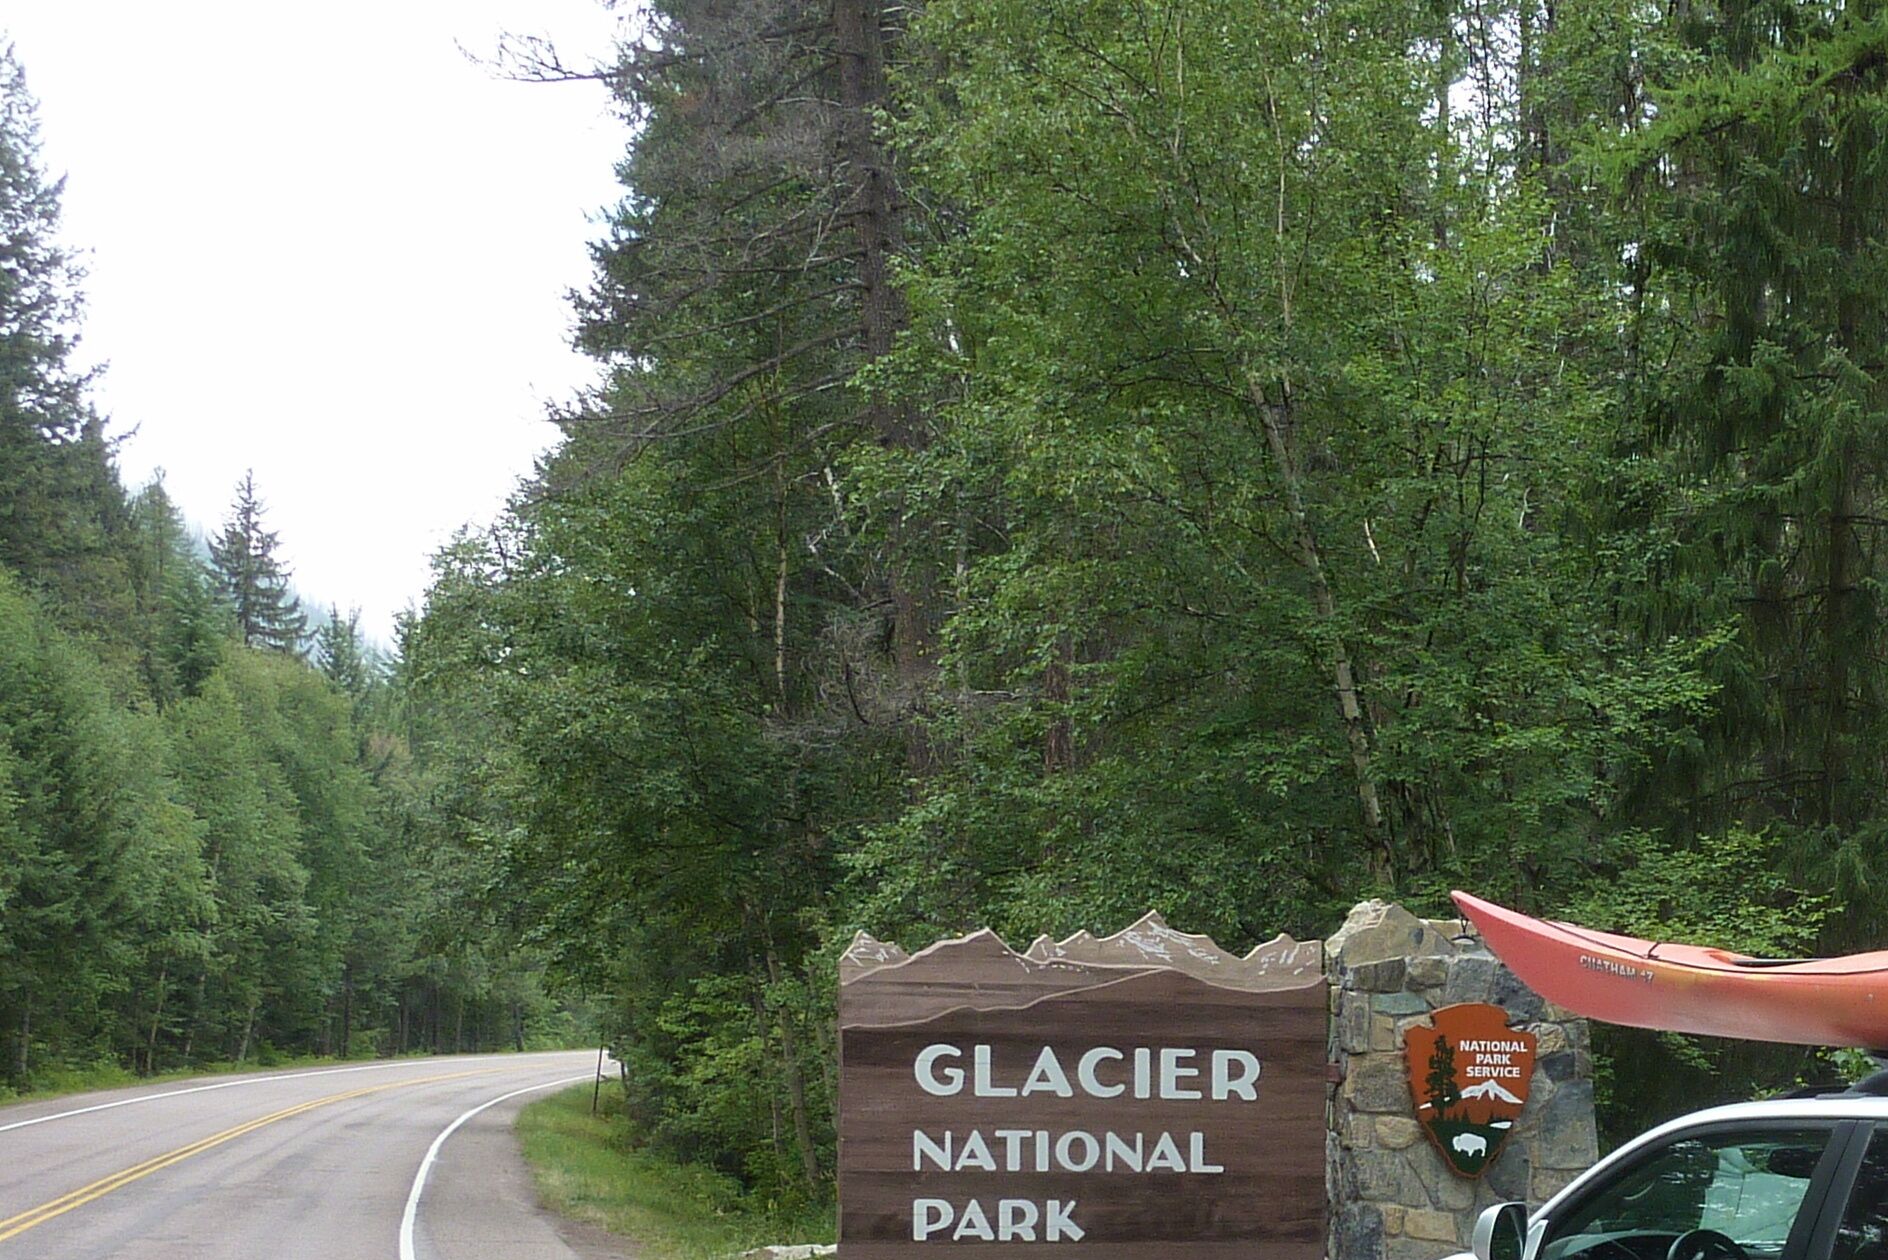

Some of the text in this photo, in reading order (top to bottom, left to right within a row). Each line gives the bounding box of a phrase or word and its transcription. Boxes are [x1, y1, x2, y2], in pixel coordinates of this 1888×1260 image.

[1579, 954, 1637, 980] CHATHAM
[1459, 1039, 1528, 1053] NATIONAL
[1475, 1053, 1512, 1065] PARK
[913, 1043, 1261, 1101] GLACIER
[1465, 1066, 1521, 1078] SERVICE
[913, 1129, 1225, 1173] NATIONAL
[913, 1198, 1086, 1242] PARK
